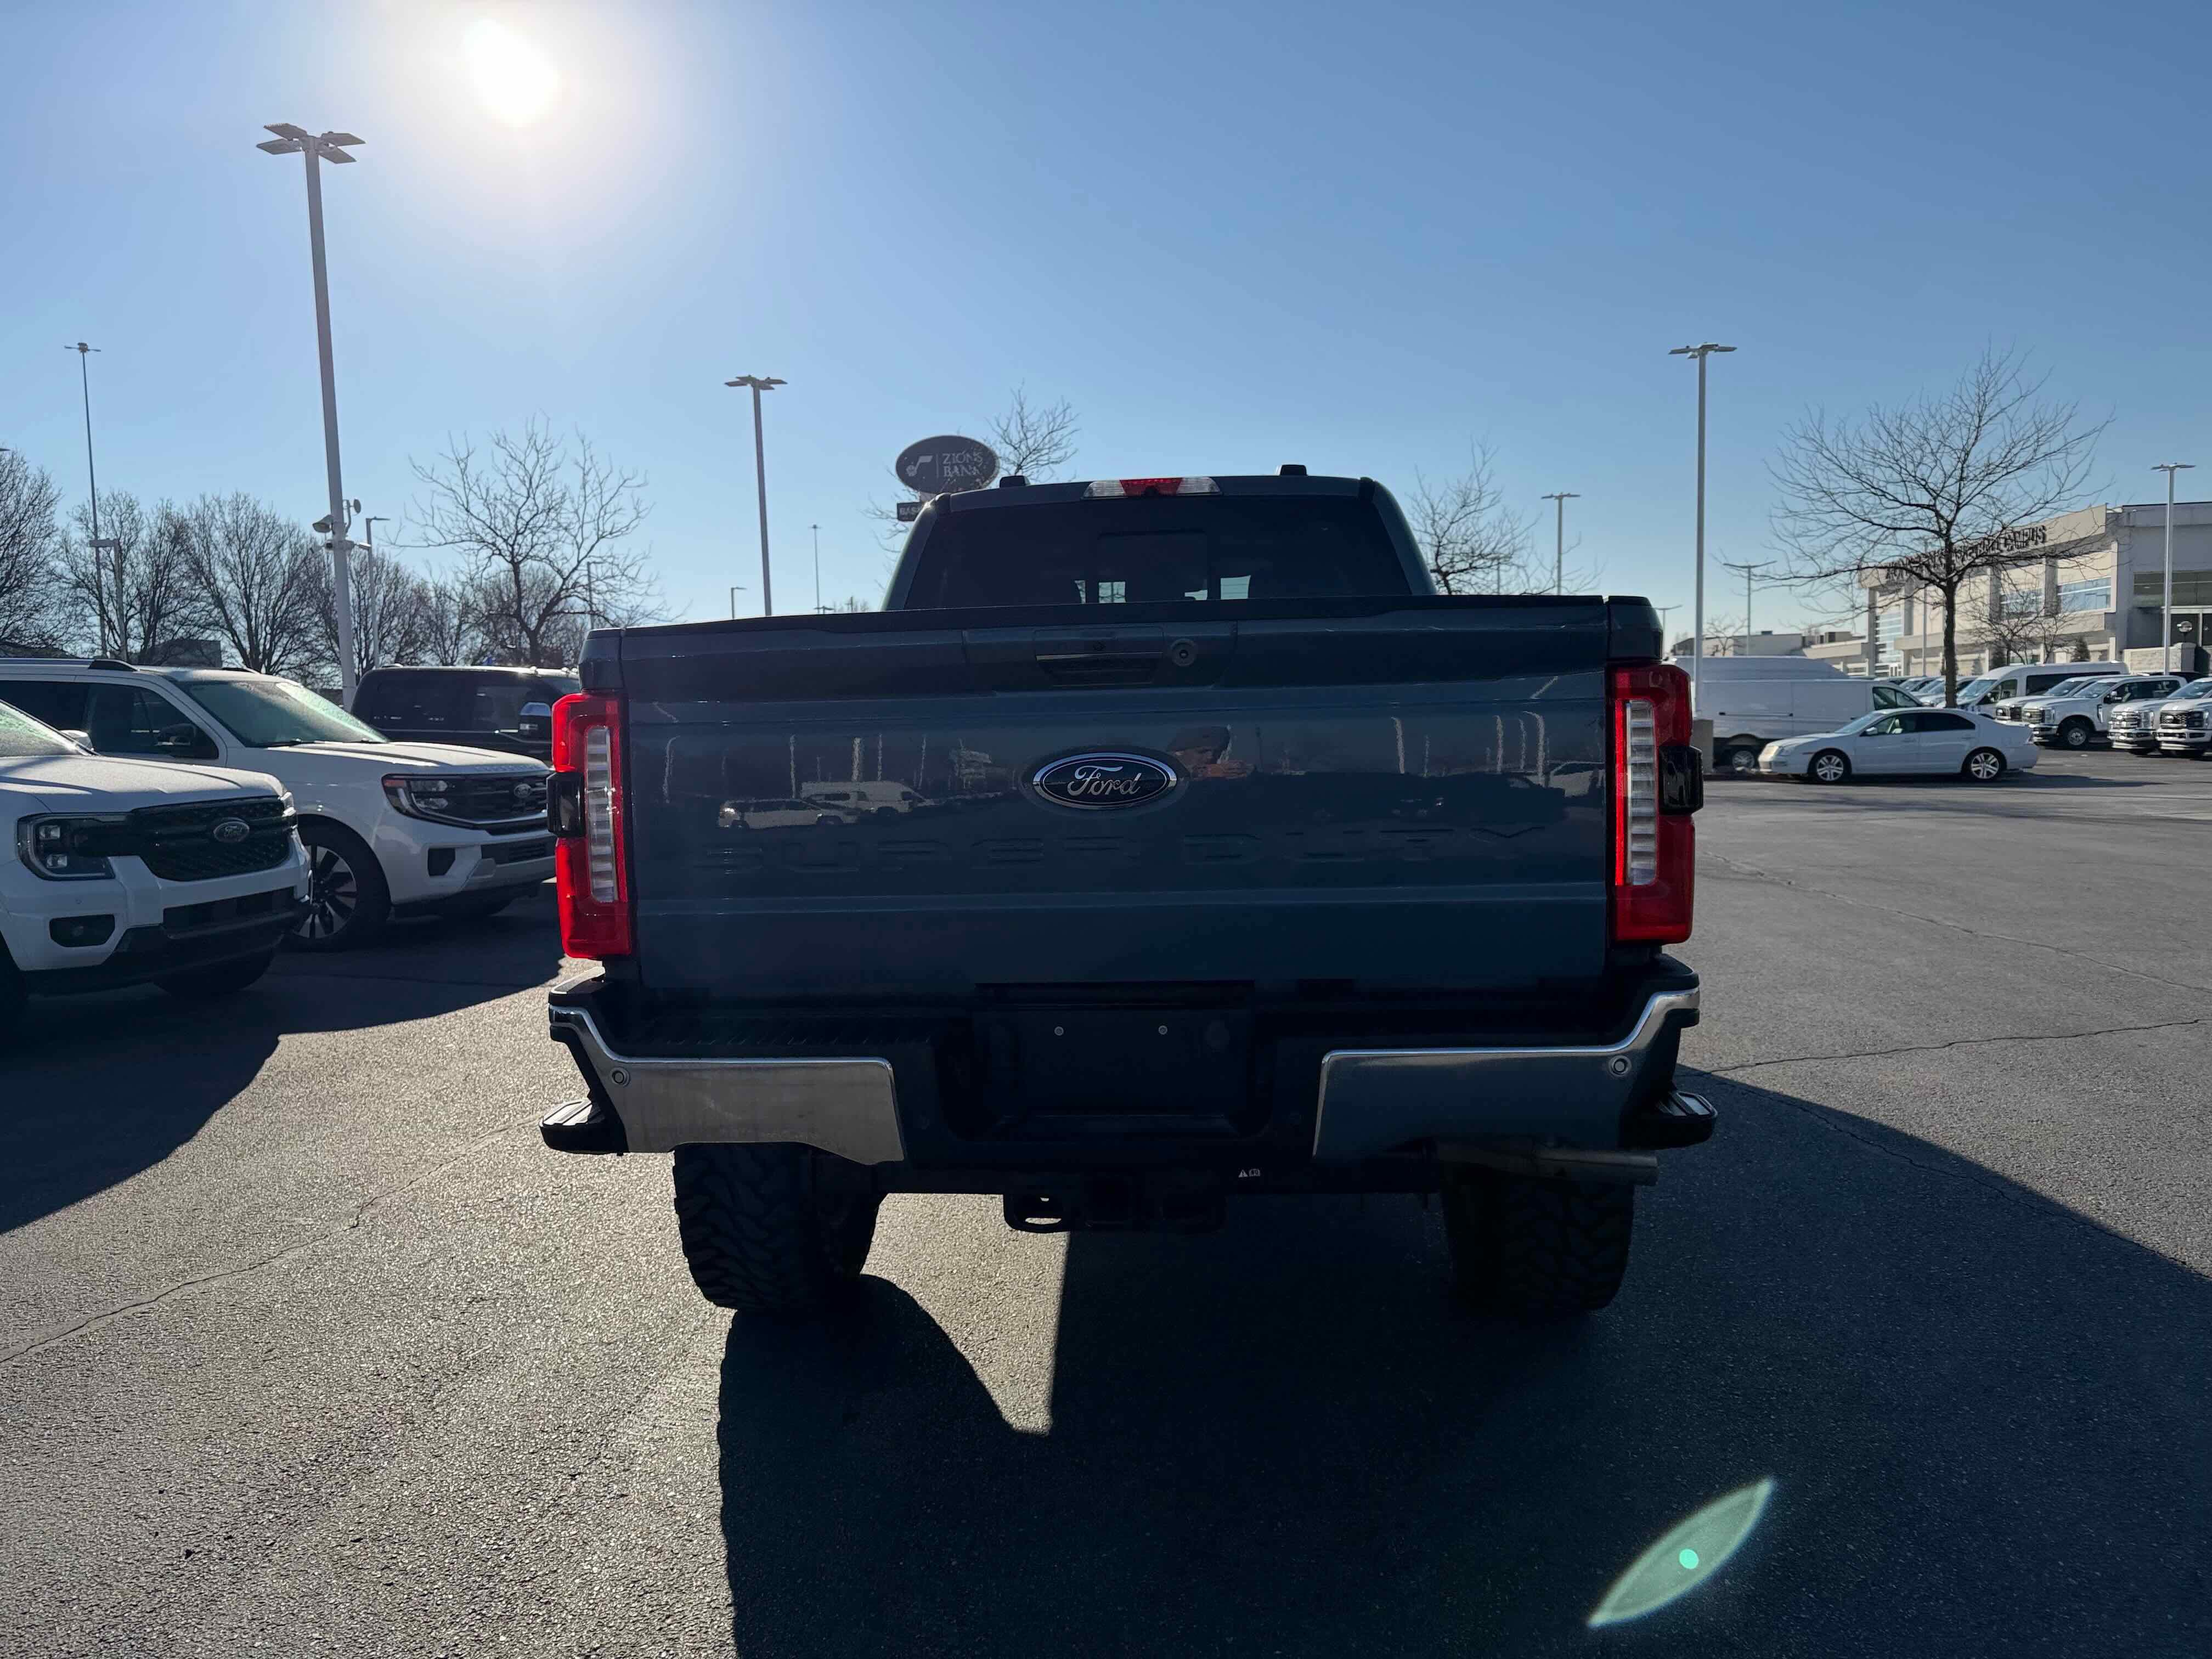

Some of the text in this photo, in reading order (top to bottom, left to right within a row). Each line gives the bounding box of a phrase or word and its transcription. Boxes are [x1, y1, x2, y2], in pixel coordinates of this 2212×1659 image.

[942, 452, 983, 465] ZIONS
[943, 465, 981, 477] BANK
[1066, 765, 1142, 795] Ford
